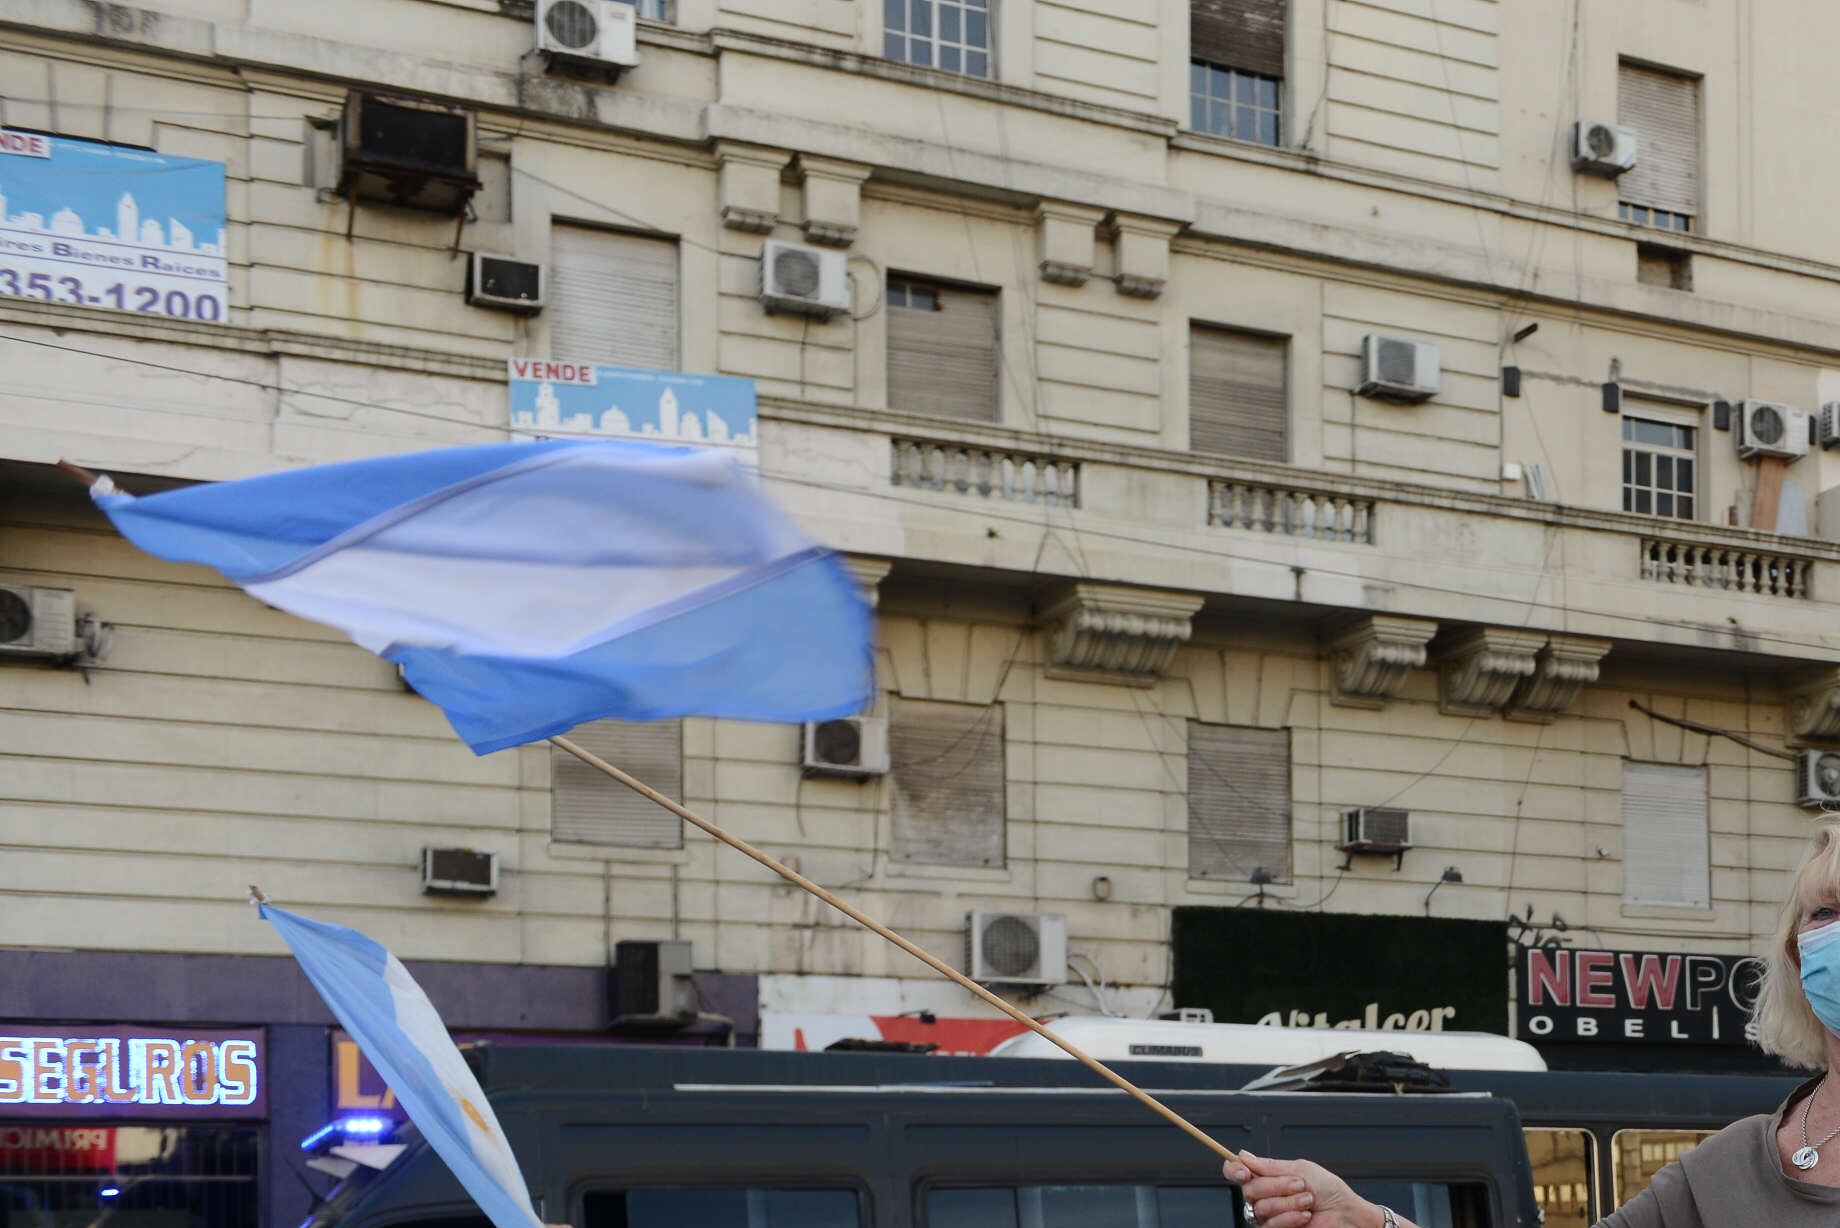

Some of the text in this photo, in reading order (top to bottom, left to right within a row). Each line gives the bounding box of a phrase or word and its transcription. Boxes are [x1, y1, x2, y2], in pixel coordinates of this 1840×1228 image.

[0, 268, 221, 322] 353-1200
[513, 361, 592, 383] VENDE
[0, 1037, 257, 1105] SEGUROS
